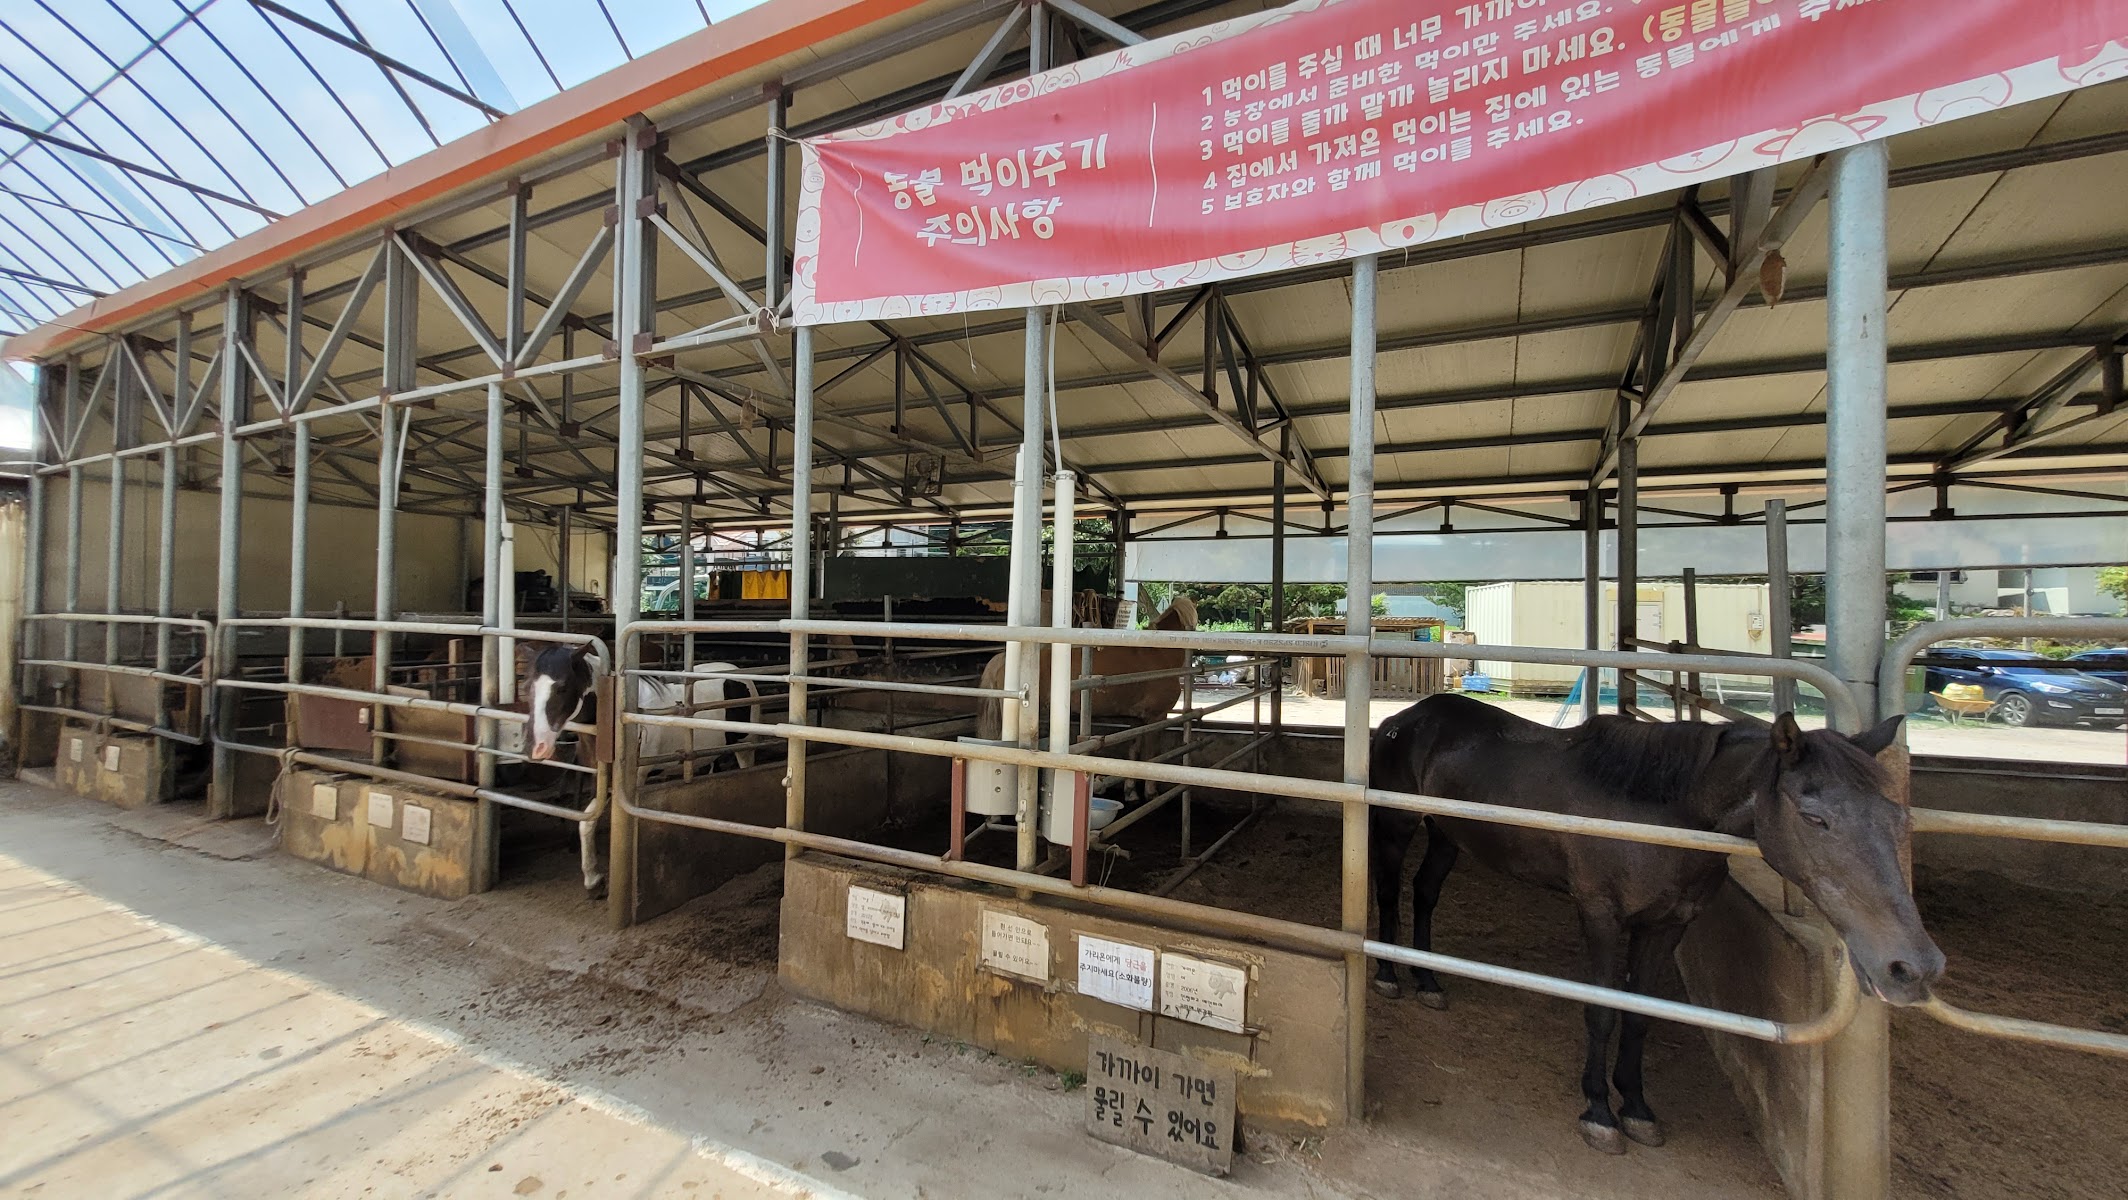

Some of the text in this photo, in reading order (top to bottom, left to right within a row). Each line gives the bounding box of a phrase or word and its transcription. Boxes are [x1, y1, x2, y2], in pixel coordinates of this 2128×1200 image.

[1200, 139, 1213, 160] 3
[1223, 117, 1289, 156] 먹이를
[1301, 102, 1349, 138] 줄까
[1360, 83, 1415, 121] 말까
[1428, 56, 1508, 104] 놀리지
[1522, 26, 1626, 75] 마세요.
[1201, 0, 1613, 131] 2 농장에서 준비한 먹이만 주세요.
[1202, 86, 1212, 106] 1
[1221, 62, 1287, 101] 먹이를
[1298, 45, 1343, 80] 주실
[1354, 33, 1382, 61] 때
[1393, 14, 1442, 50] 너무
[1203, 13, 1781, 190] 4 집에서 가져온 먹이는 집에 있는 동물에게
[884, 133, 1109, 209] 동물 먹이주기
[1201, 110, 1584, 215] 5 보호자와 함께 먹이를 주세요.
[916, 196, 1063, 248] 주의사항
[1085, 949, 1147, 972] 가리온에게 당근을
[1096, 1051, 1216, 1106] 가까이 가면
[1133, 1098, 1154, 1136] 수
[1167, 1110, 1220, 1150] 있어요
